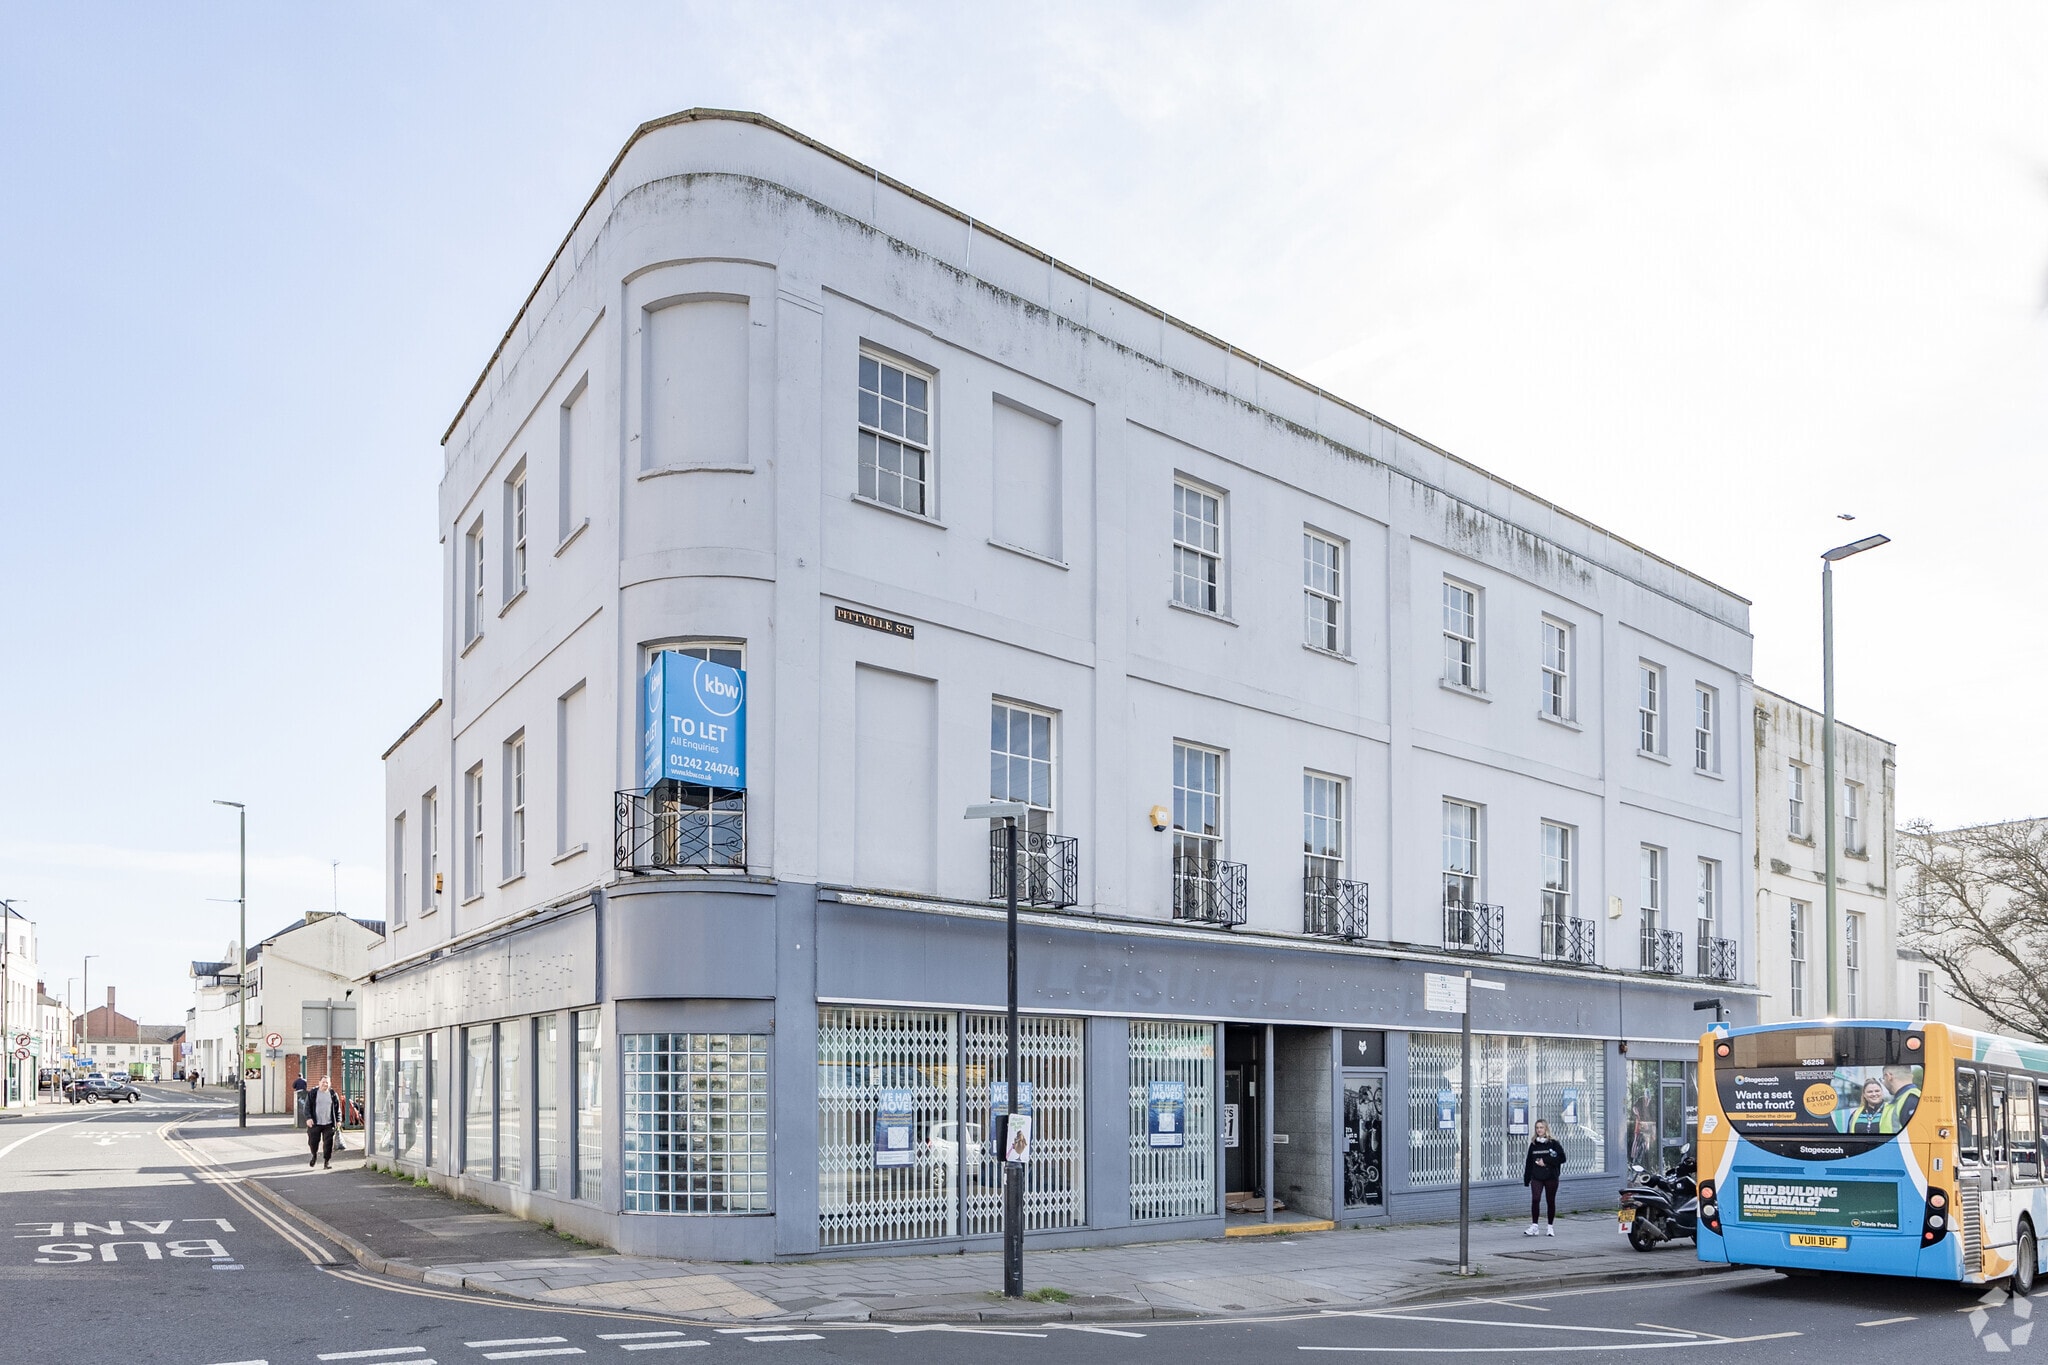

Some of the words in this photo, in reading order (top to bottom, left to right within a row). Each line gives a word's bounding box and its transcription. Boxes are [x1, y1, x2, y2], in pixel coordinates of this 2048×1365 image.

[837, 608, 893, 631] PITTVILLE
[705, 674, 738, 699] kbw
[670, 715, 696, 736] TO
[700, 721, 728, 742] LET
[670, 736, 682, 746] All
[683, 740, 719, 753] Enquiries
[670, 754, 702, 770] 01242
[704, 760, 740, 777] 244744
[670, 767, 712, 781] www.kbw.co.uk
[1744, 1076, 1779, 1085] Stagecoach
[992, 1085, 1008, 1093] WE
[1151, 1084, 1164, 1092] WE
[1164, 1084, 1183, 1092] HAVE
[880, 1092, 894, 1102] WE
[1151, 1091, 1182, 1100] MOVED!
[1735, 1091, 1762, 1099] Want
[1771, 1091, 1792, 1099] seat
[1806, 1093, 1835, 1103] £31,000
[1735, 1101, 1746, 1109] at
[1747, 1101, 1763, 1109] the
[1764, 1100, 1795, 1109] front?
[1800, 1146, 1844, 1154] Stagecoach
[1743, 1184, 1777, 1195] NEED
[1777, 1186, 1838, 1198] BUILDING
[1743, 1194, 1822, 1207] MATERIALS?
[14, 1218, 236, 1238] LANE
[1798, 1235, 1817, 1245] VU11
[1819, 1236, 1838, 1246] BUF
[34, 1239, 230, 1263] BUS
